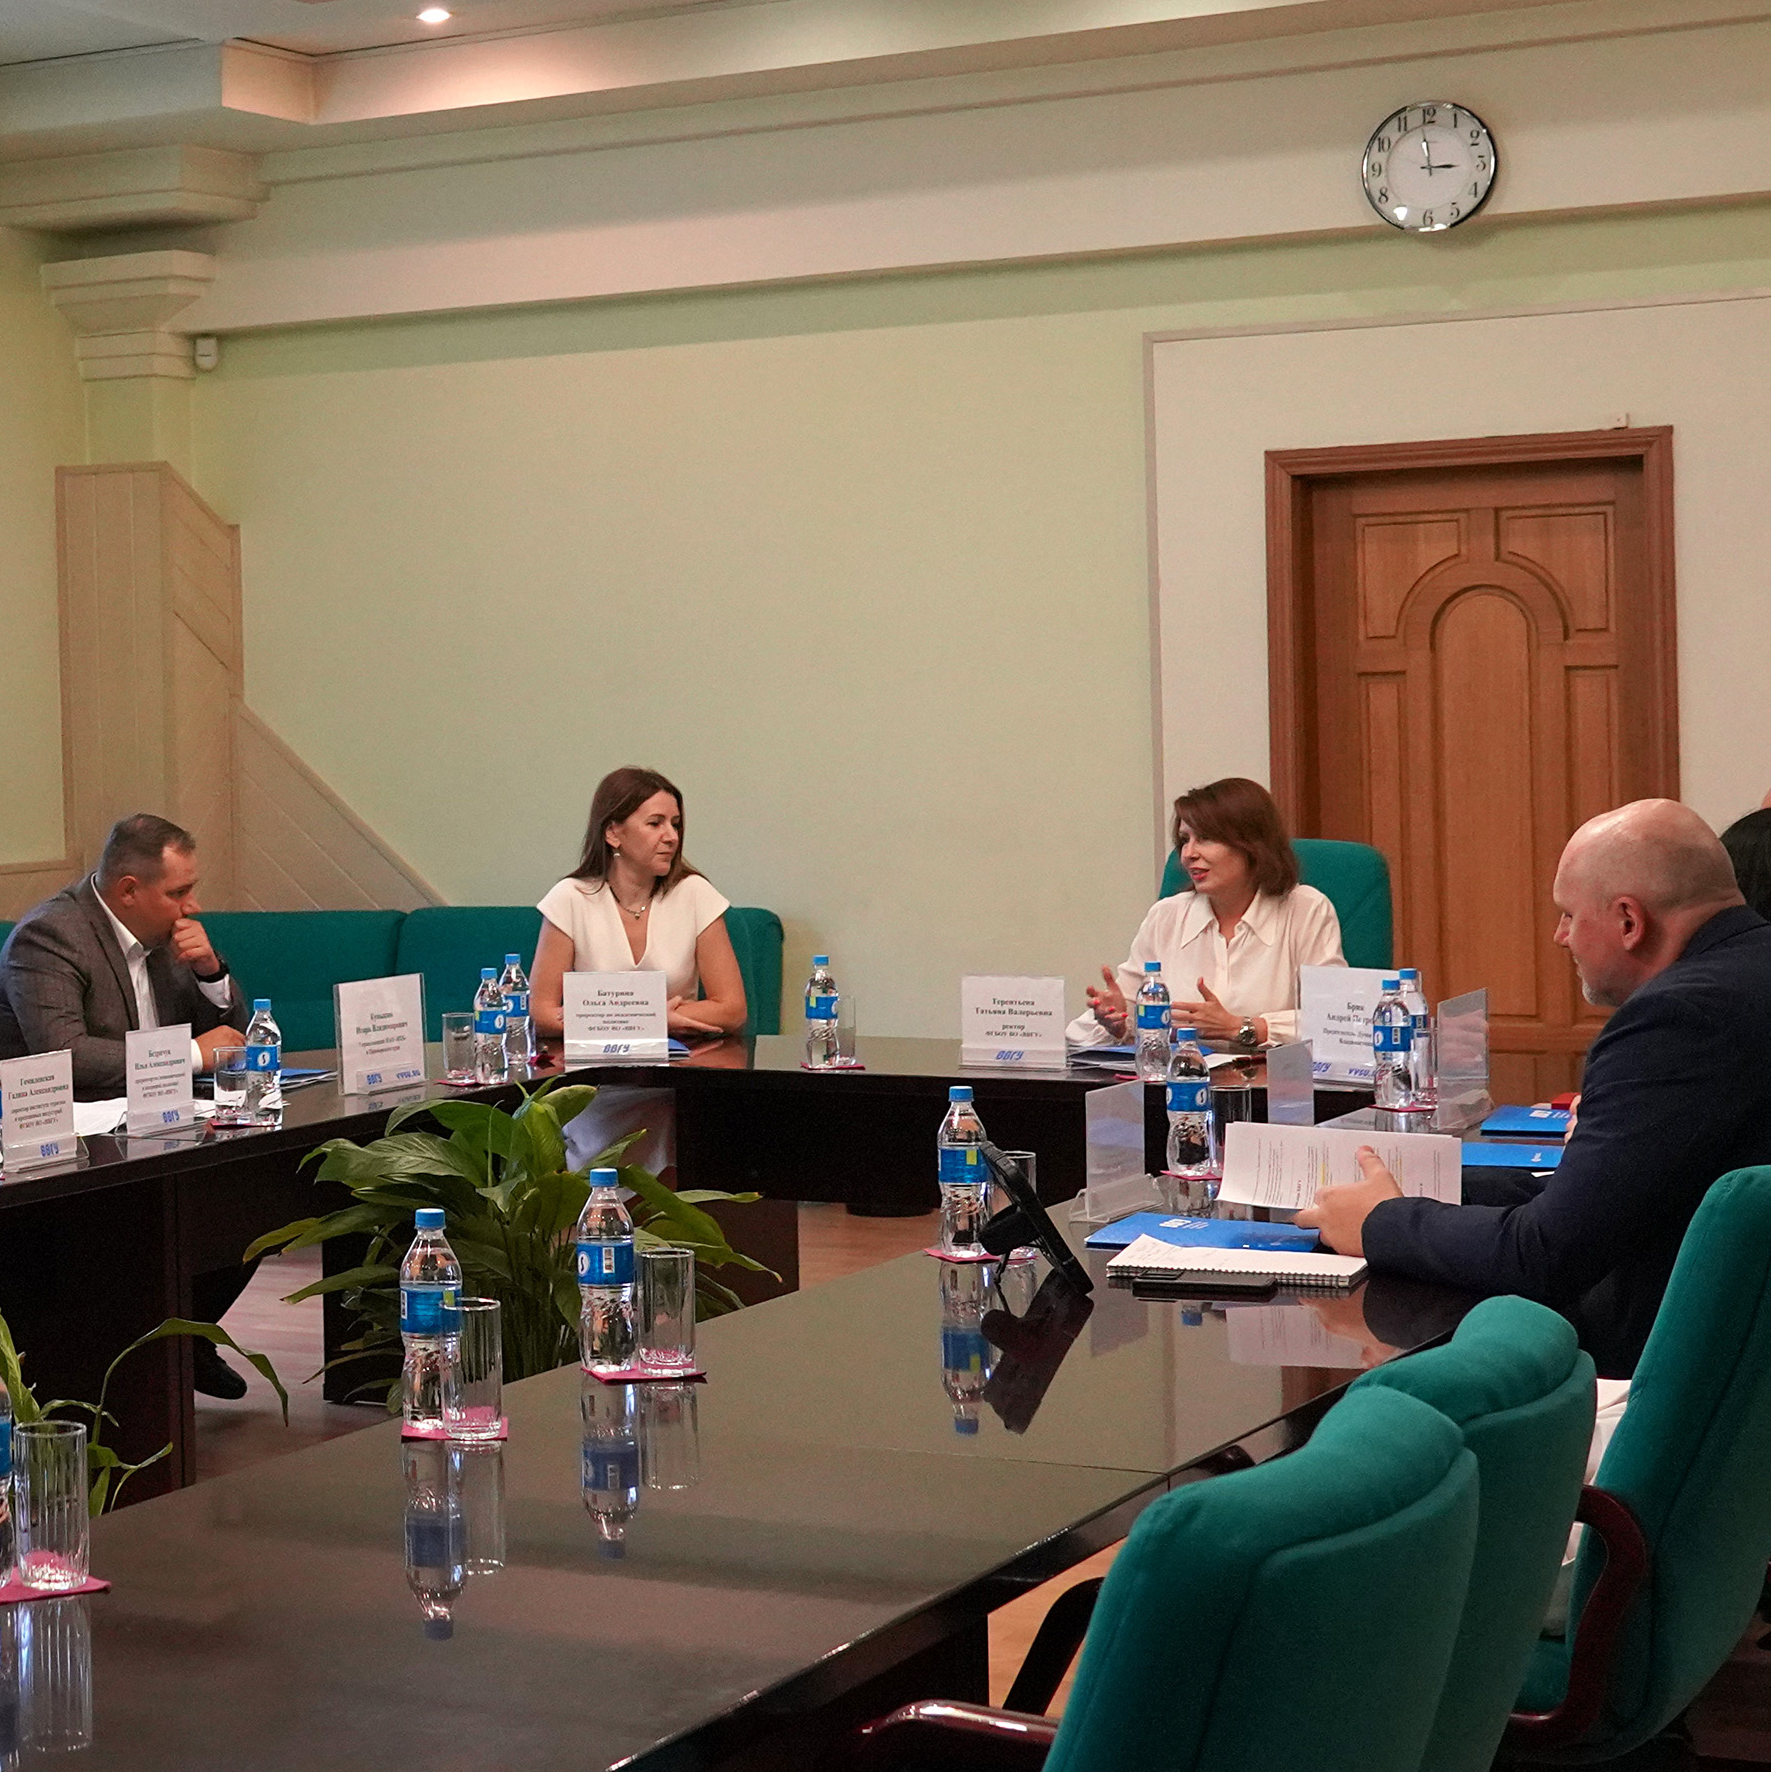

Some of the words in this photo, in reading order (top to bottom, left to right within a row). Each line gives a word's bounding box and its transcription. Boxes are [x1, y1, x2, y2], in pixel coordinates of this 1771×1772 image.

[1397, 116, 1408, 132] 11
[1422, 107, 1436, 125] 12
[1453, 112, 1458, 128] 1
[1377, 136, 1391, 153] 10
[1470, 130, 1481, 147] 2
[1371, 163, 1382, 178] 9
[1378, 187, 1389, 204] 8
[1468, 182, 1478, 198] 4
[1422, 209, 1434, 227] 6
[1450, 202, 1461, 219] 5
[975, 1007, 1006, 1015] Татьяна
